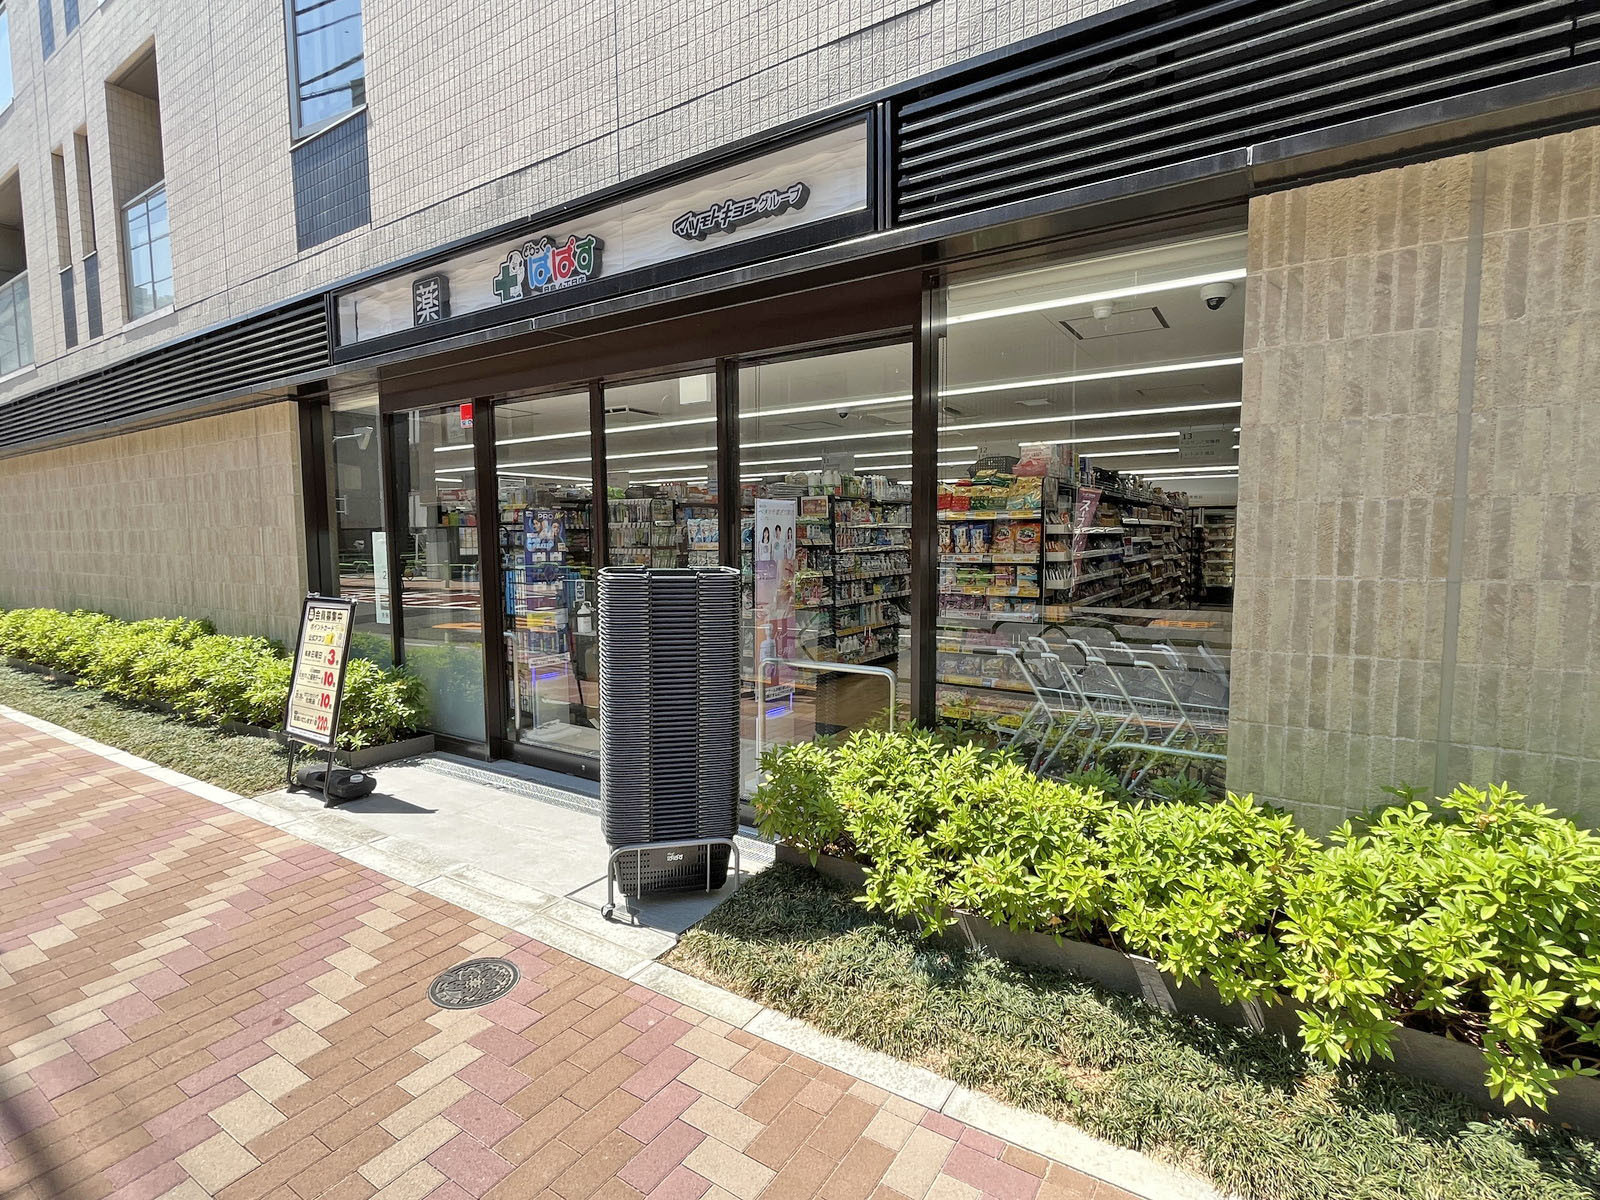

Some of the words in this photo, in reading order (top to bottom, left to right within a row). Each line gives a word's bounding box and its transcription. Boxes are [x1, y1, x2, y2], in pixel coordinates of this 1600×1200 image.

[674, 183, 803, 235] マツモトキヨシグループ
[528, 237, 595, 288] ぱぱす
[416, 281, 439, 324] 薬
[1183, 432, 1193, 440] 13
